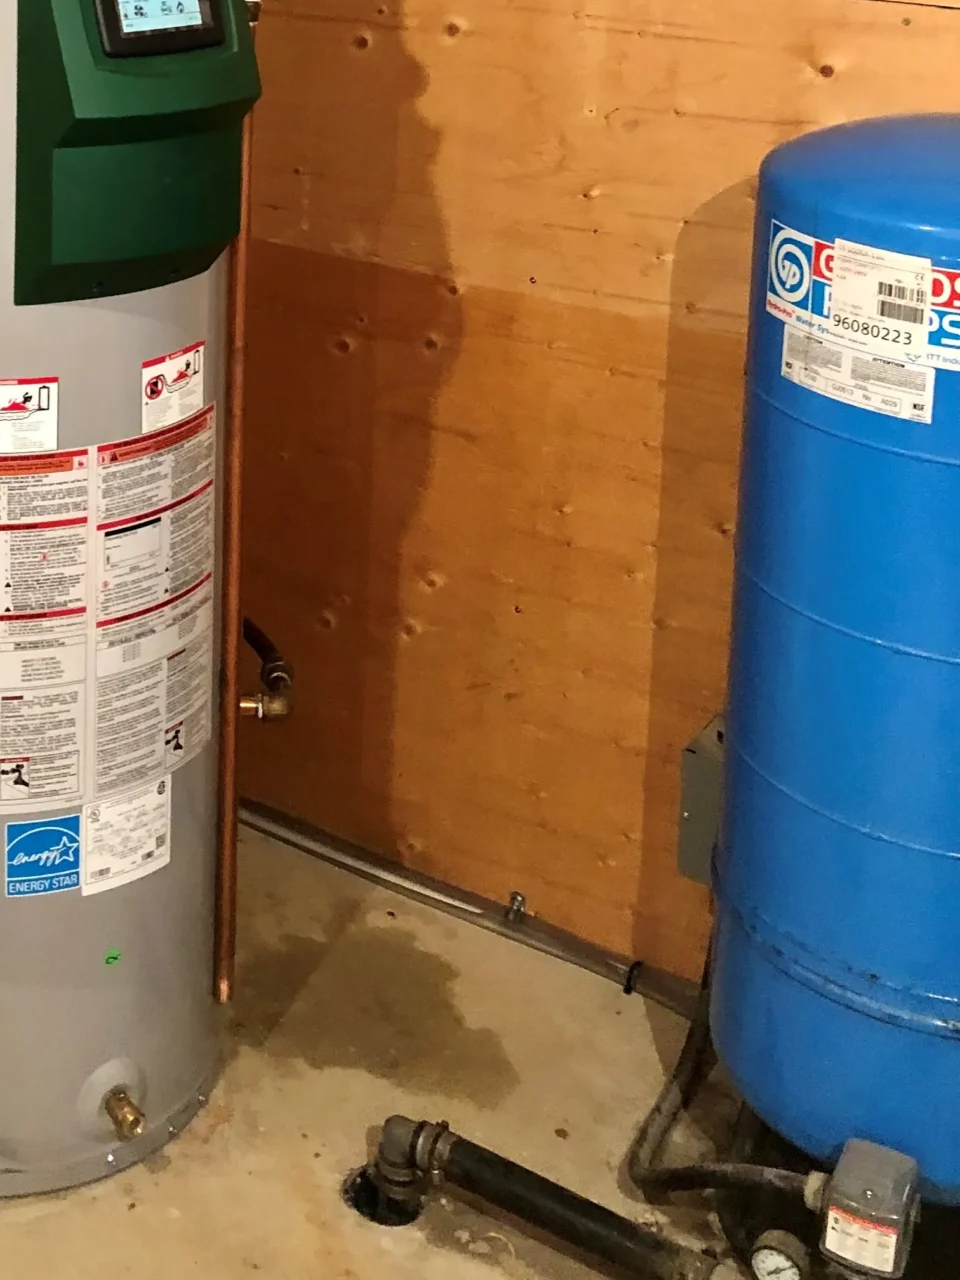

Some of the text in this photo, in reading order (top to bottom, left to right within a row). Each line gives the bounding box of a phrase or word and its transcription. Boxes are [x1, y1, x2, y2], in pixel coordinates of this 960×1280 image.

[833, 313, 913, 346] 96080223
[8, 874, 78, 893] ENERGY STAR
